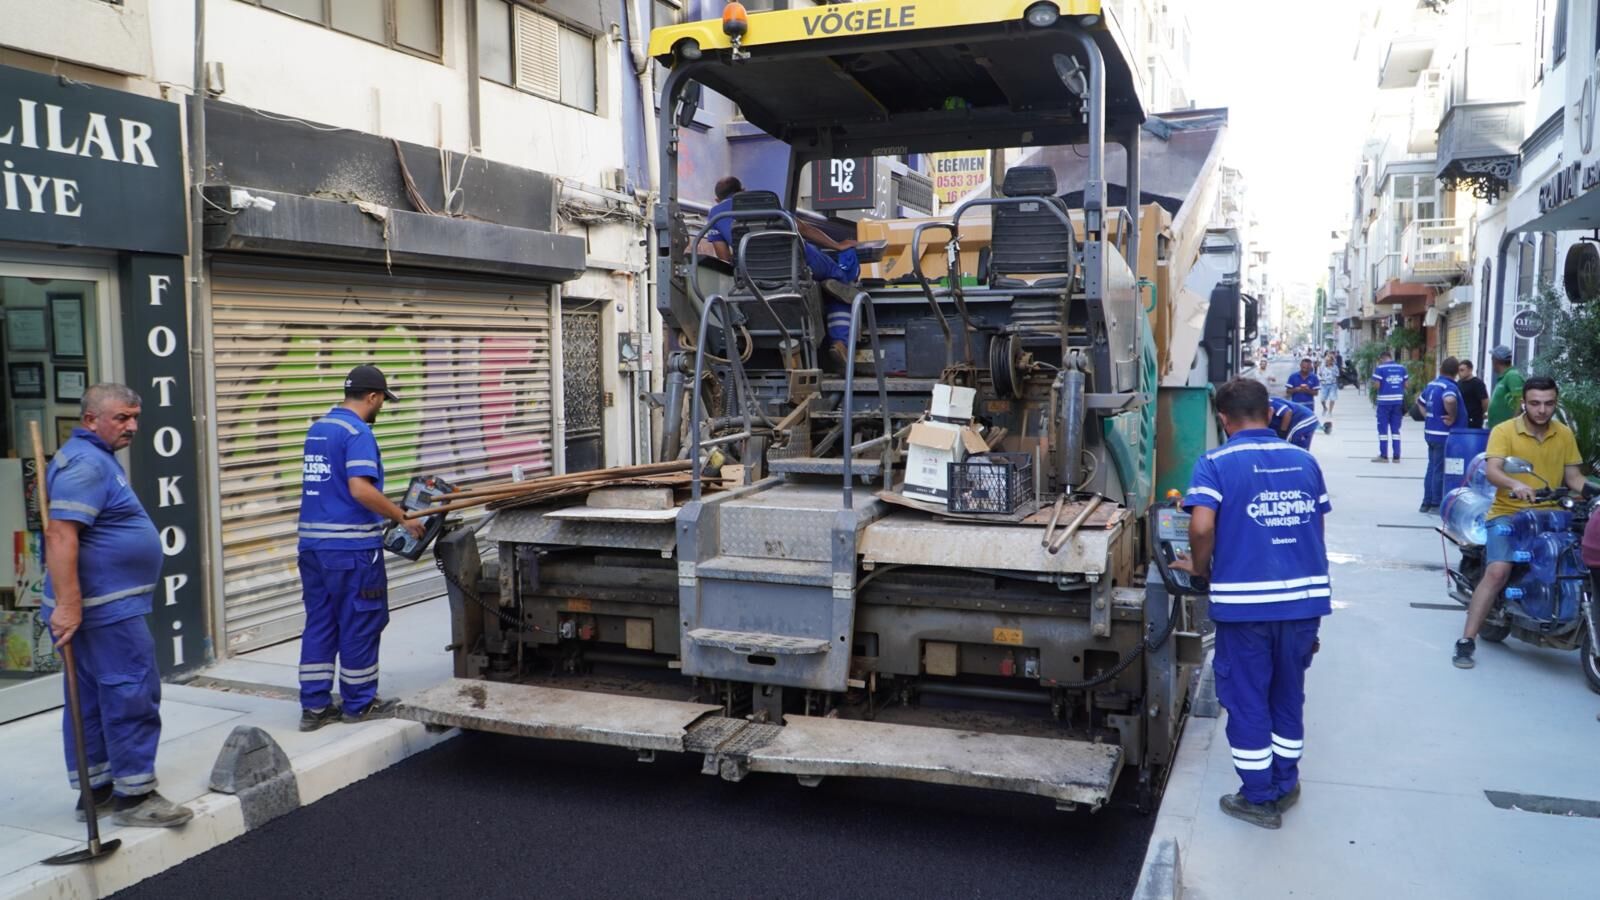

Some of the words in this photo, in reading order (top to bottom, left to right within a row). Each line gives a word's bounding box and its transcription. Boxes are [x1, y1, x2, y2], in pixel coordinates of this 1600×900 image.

[802, 5, 916, 36] VÖGELE
[937, 157, 985, 173] EGEMEN
[936, 174, 964, 188] 0533
